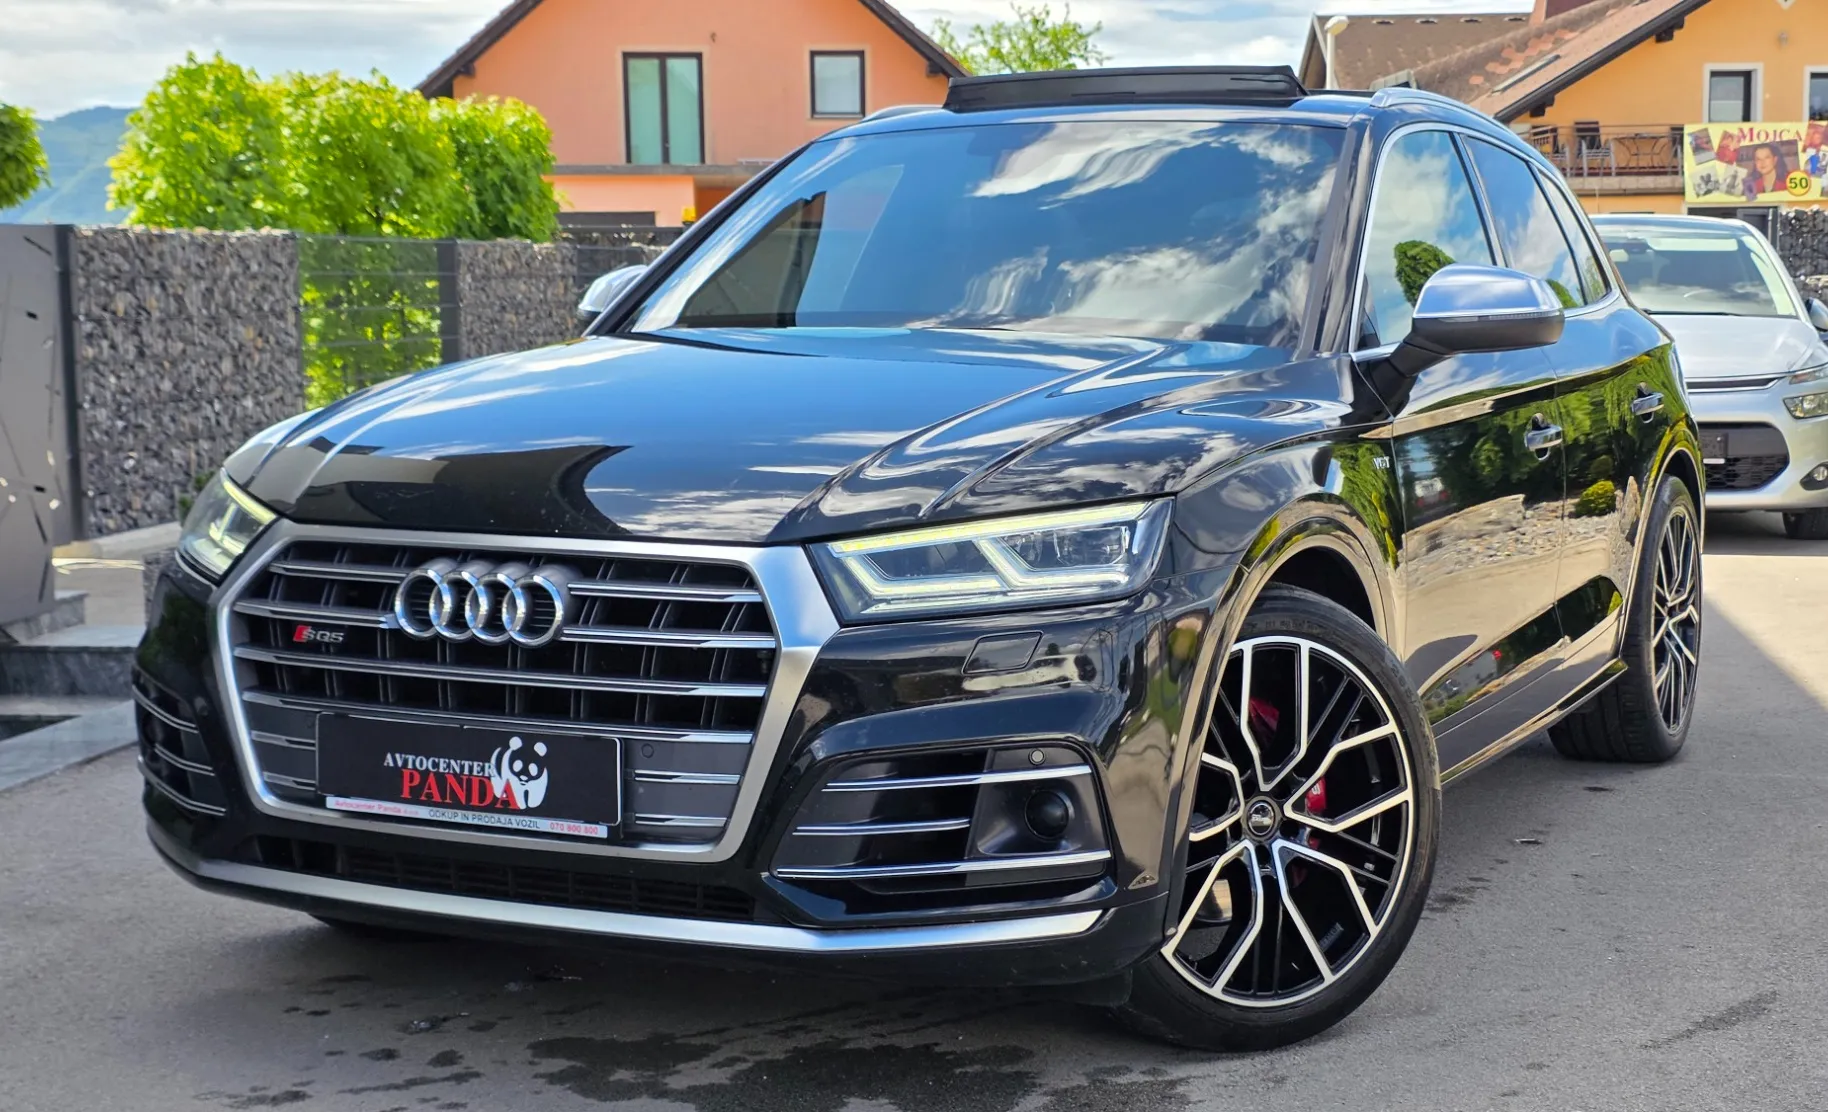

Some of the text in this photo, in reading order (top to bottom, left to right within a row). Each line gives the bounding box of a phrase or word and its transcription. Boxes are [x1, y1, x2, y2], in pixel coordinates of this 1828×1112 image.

[1788, 177, 1809, 189] 50
[298, 625, 345, 643] SQ5
[383, 751, 496, 778] AVTOCENTER
[400, 768, 520, 811] PANDA
[428, 808, 459, 821] ODKUP
[460, 812, 470, 821] IN
[471, 813, 514, 827] PRODAJA
[514, 818, 540, 829] VOZIL
